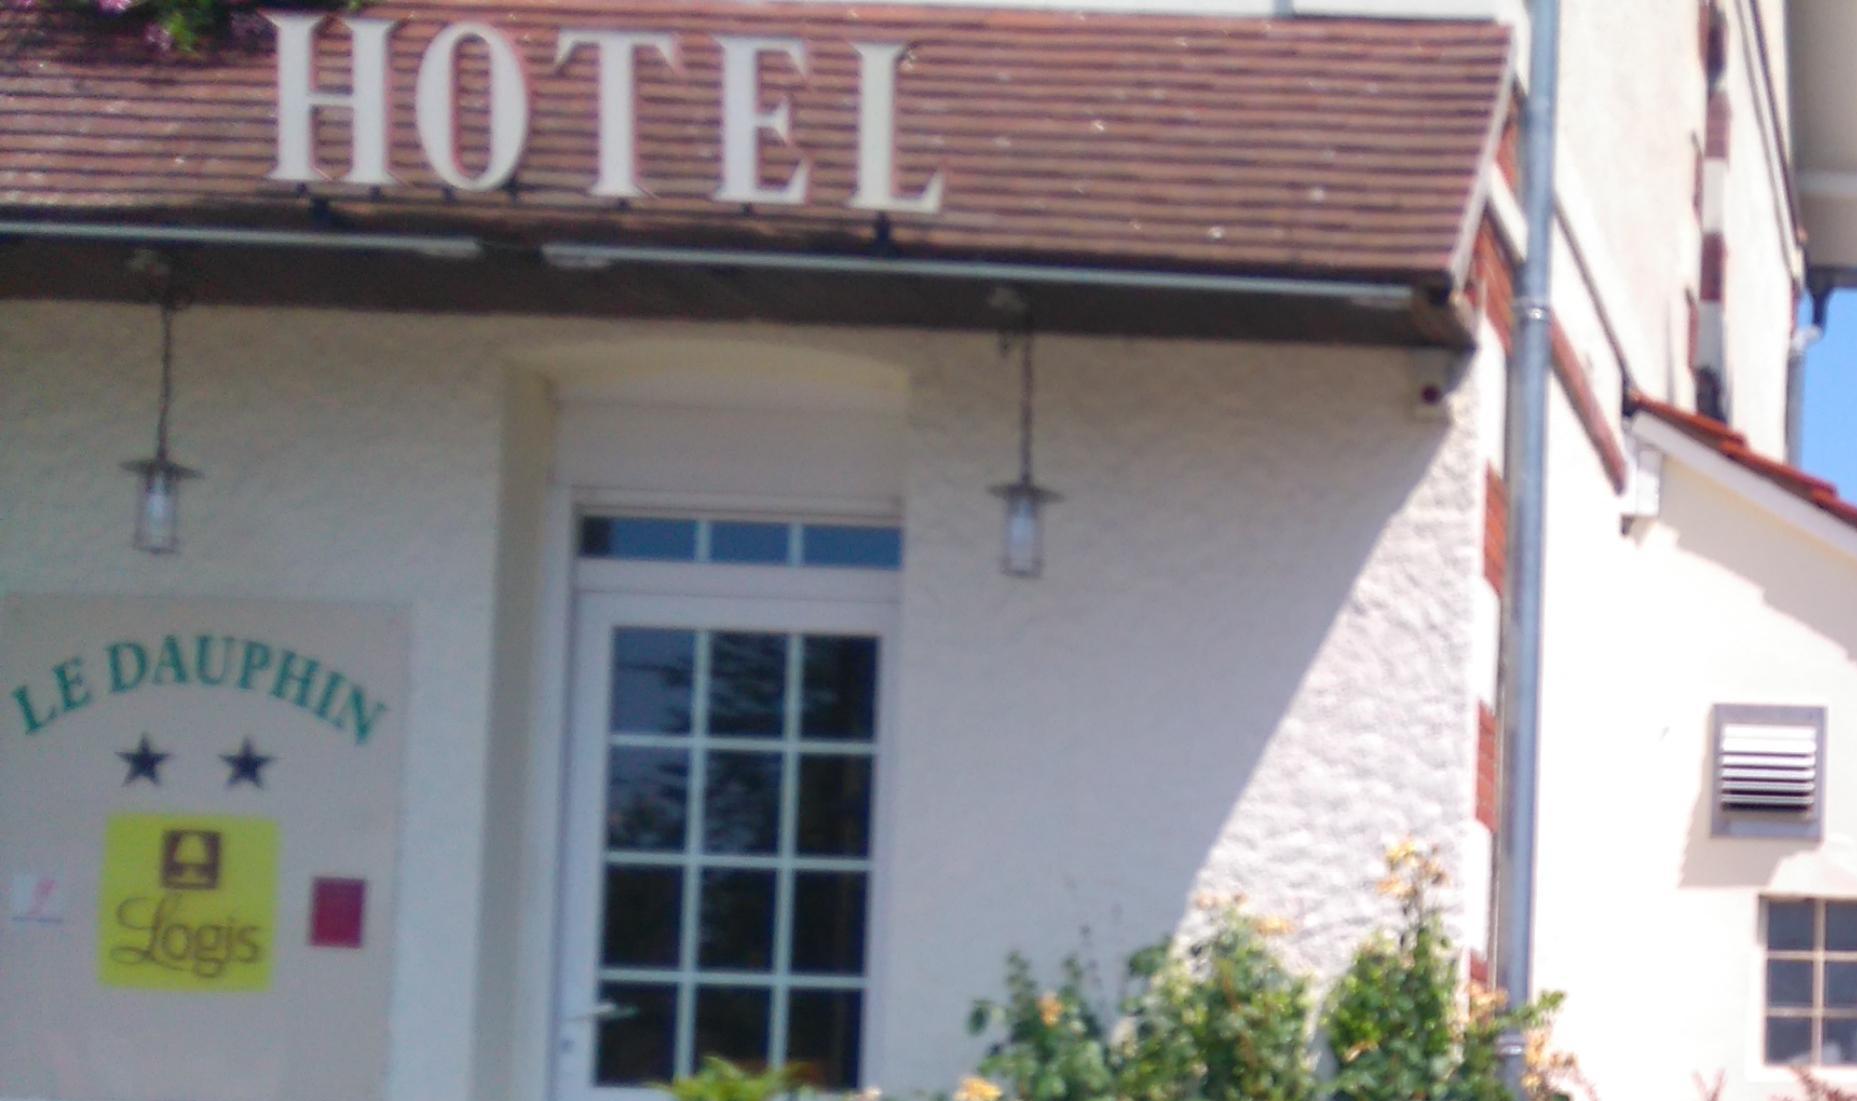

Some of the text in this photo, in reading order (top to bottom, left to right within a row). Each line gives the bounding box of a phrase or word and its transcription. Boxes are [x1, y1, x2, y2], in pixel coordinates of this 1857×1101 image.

[266, 13, 946, 214] HOTEL
[12, 633, 389, 747] LE DAUPHIN
[109, 893, 265, 980] Logis
